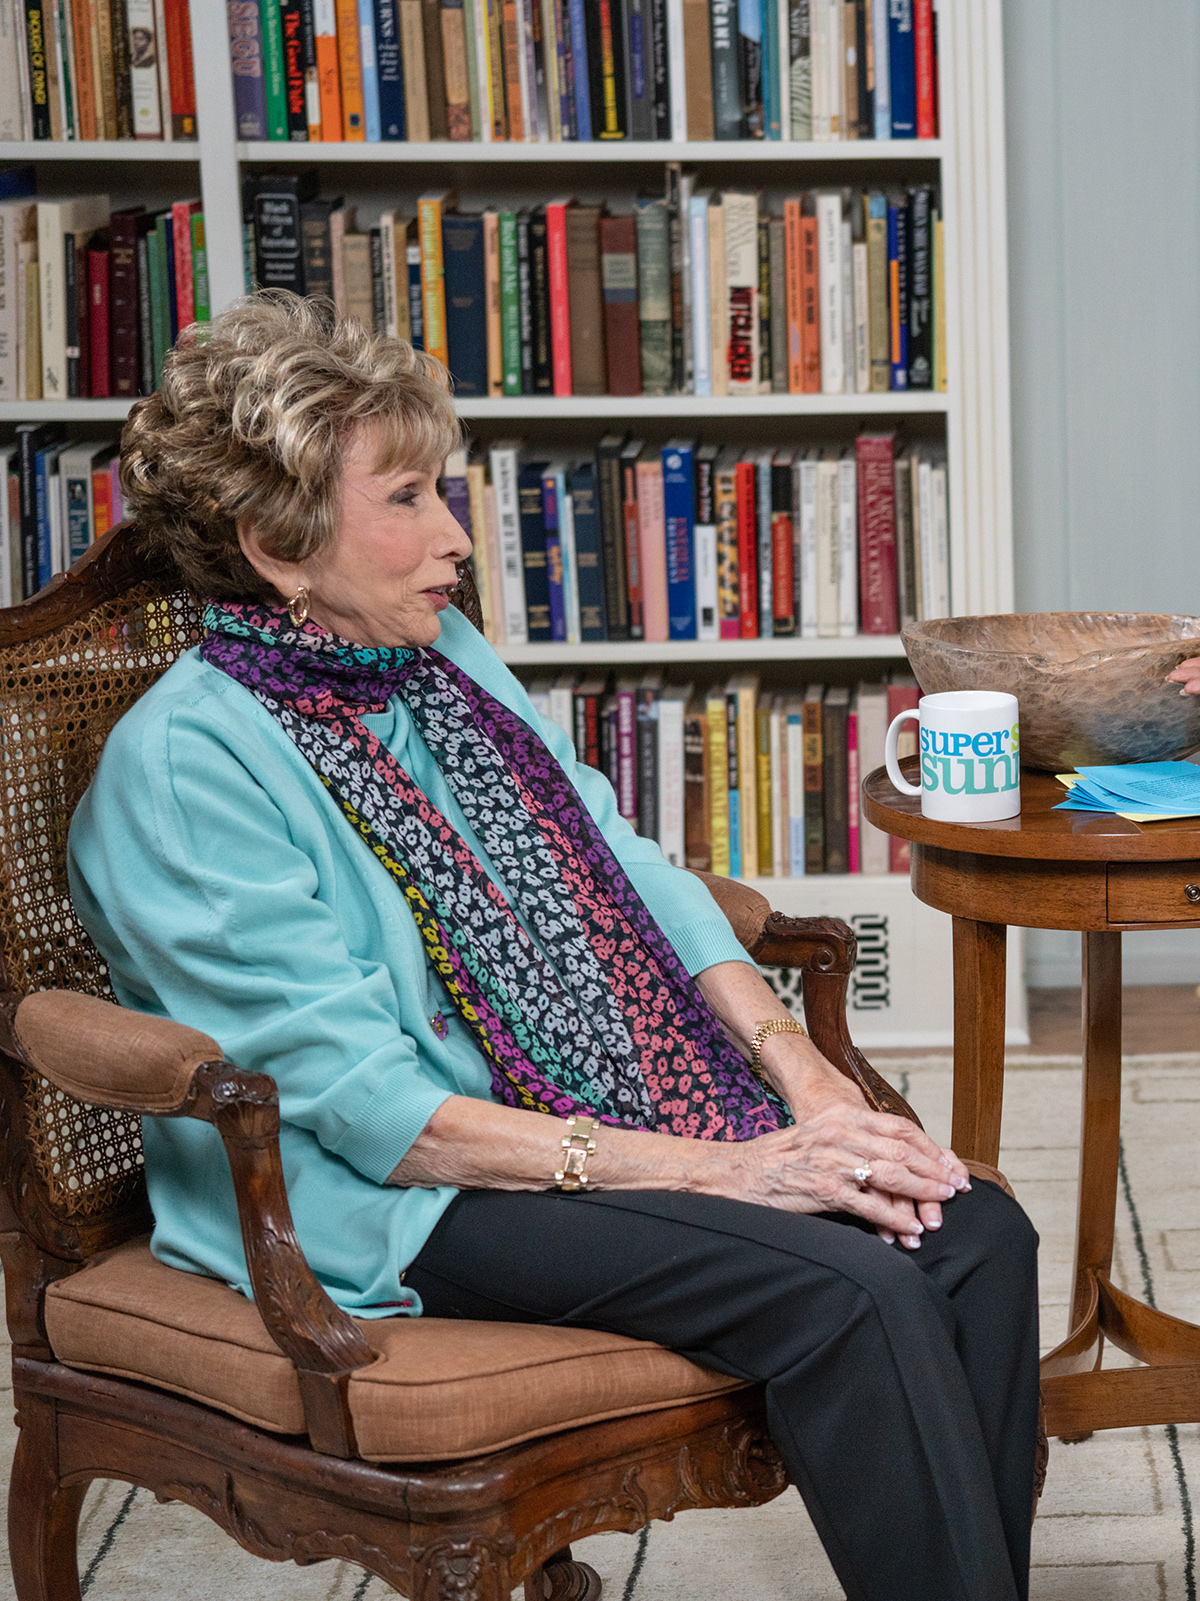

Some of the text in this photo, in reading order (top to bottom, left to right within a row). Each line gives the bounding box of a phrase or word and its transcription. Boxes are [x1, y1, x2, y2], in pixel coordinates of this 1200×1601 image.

[29, 10, 44, 52] ENOUGH
[33, 53, 45, 68] OF
[228, 2, 261, 77] SEGU
[504, 247, 518, 270] and
[730, 285, 753, 381] NUTCRACKER
[70, 509, 88, 549] Paul
[865, 462, 882, 602] MEXICAN COOKING
[879, 462, 894, 541] THE ART OF
[667, 517, 679, 584] TREATMENT
[676, 517, 689, 582] UNEQUAL
[620, 696, 632, 734] SIGNS
[621, 757, 634, 816] WONDERS
